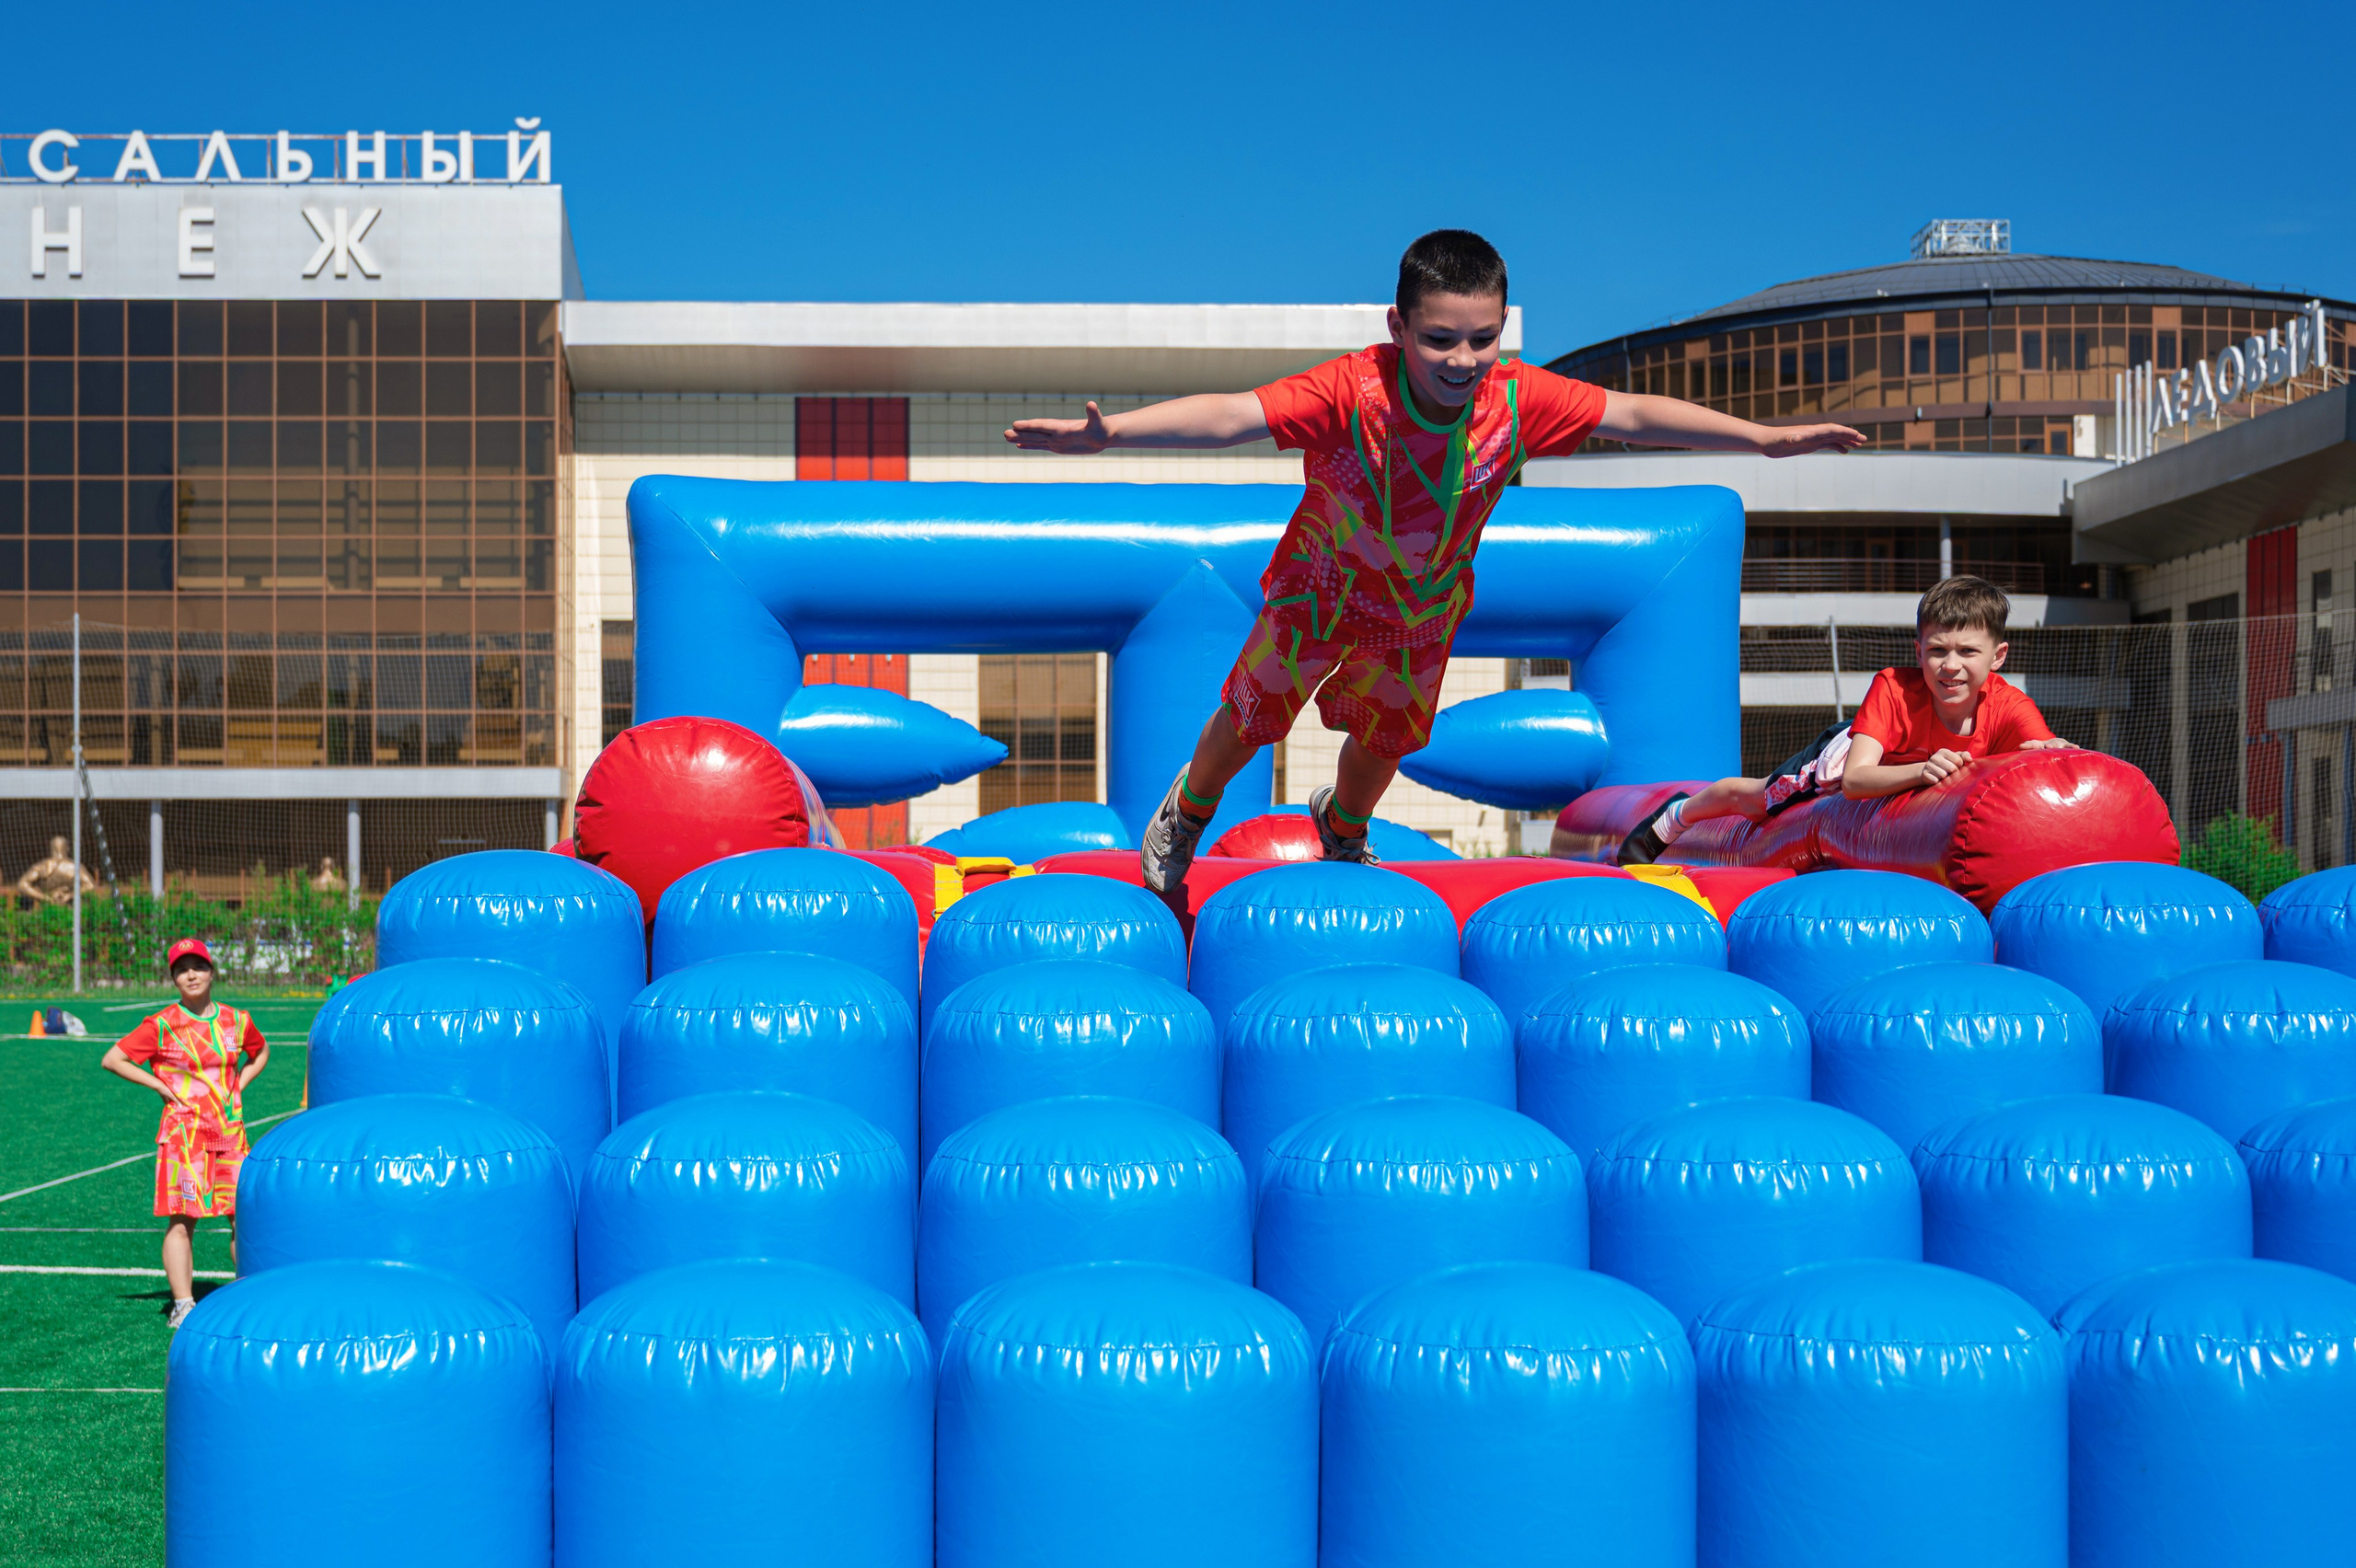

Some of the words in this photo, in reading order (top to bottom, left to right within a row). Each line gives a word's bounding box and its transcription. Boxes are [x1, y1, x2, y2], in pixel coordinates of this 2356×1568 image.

[29, 118, 550, 182] САЛЬНЫЙ
[31, 207, 381, 278] НЕЖ
[2150, 299, 2326, 433] ЛЕДОВЫЙ
